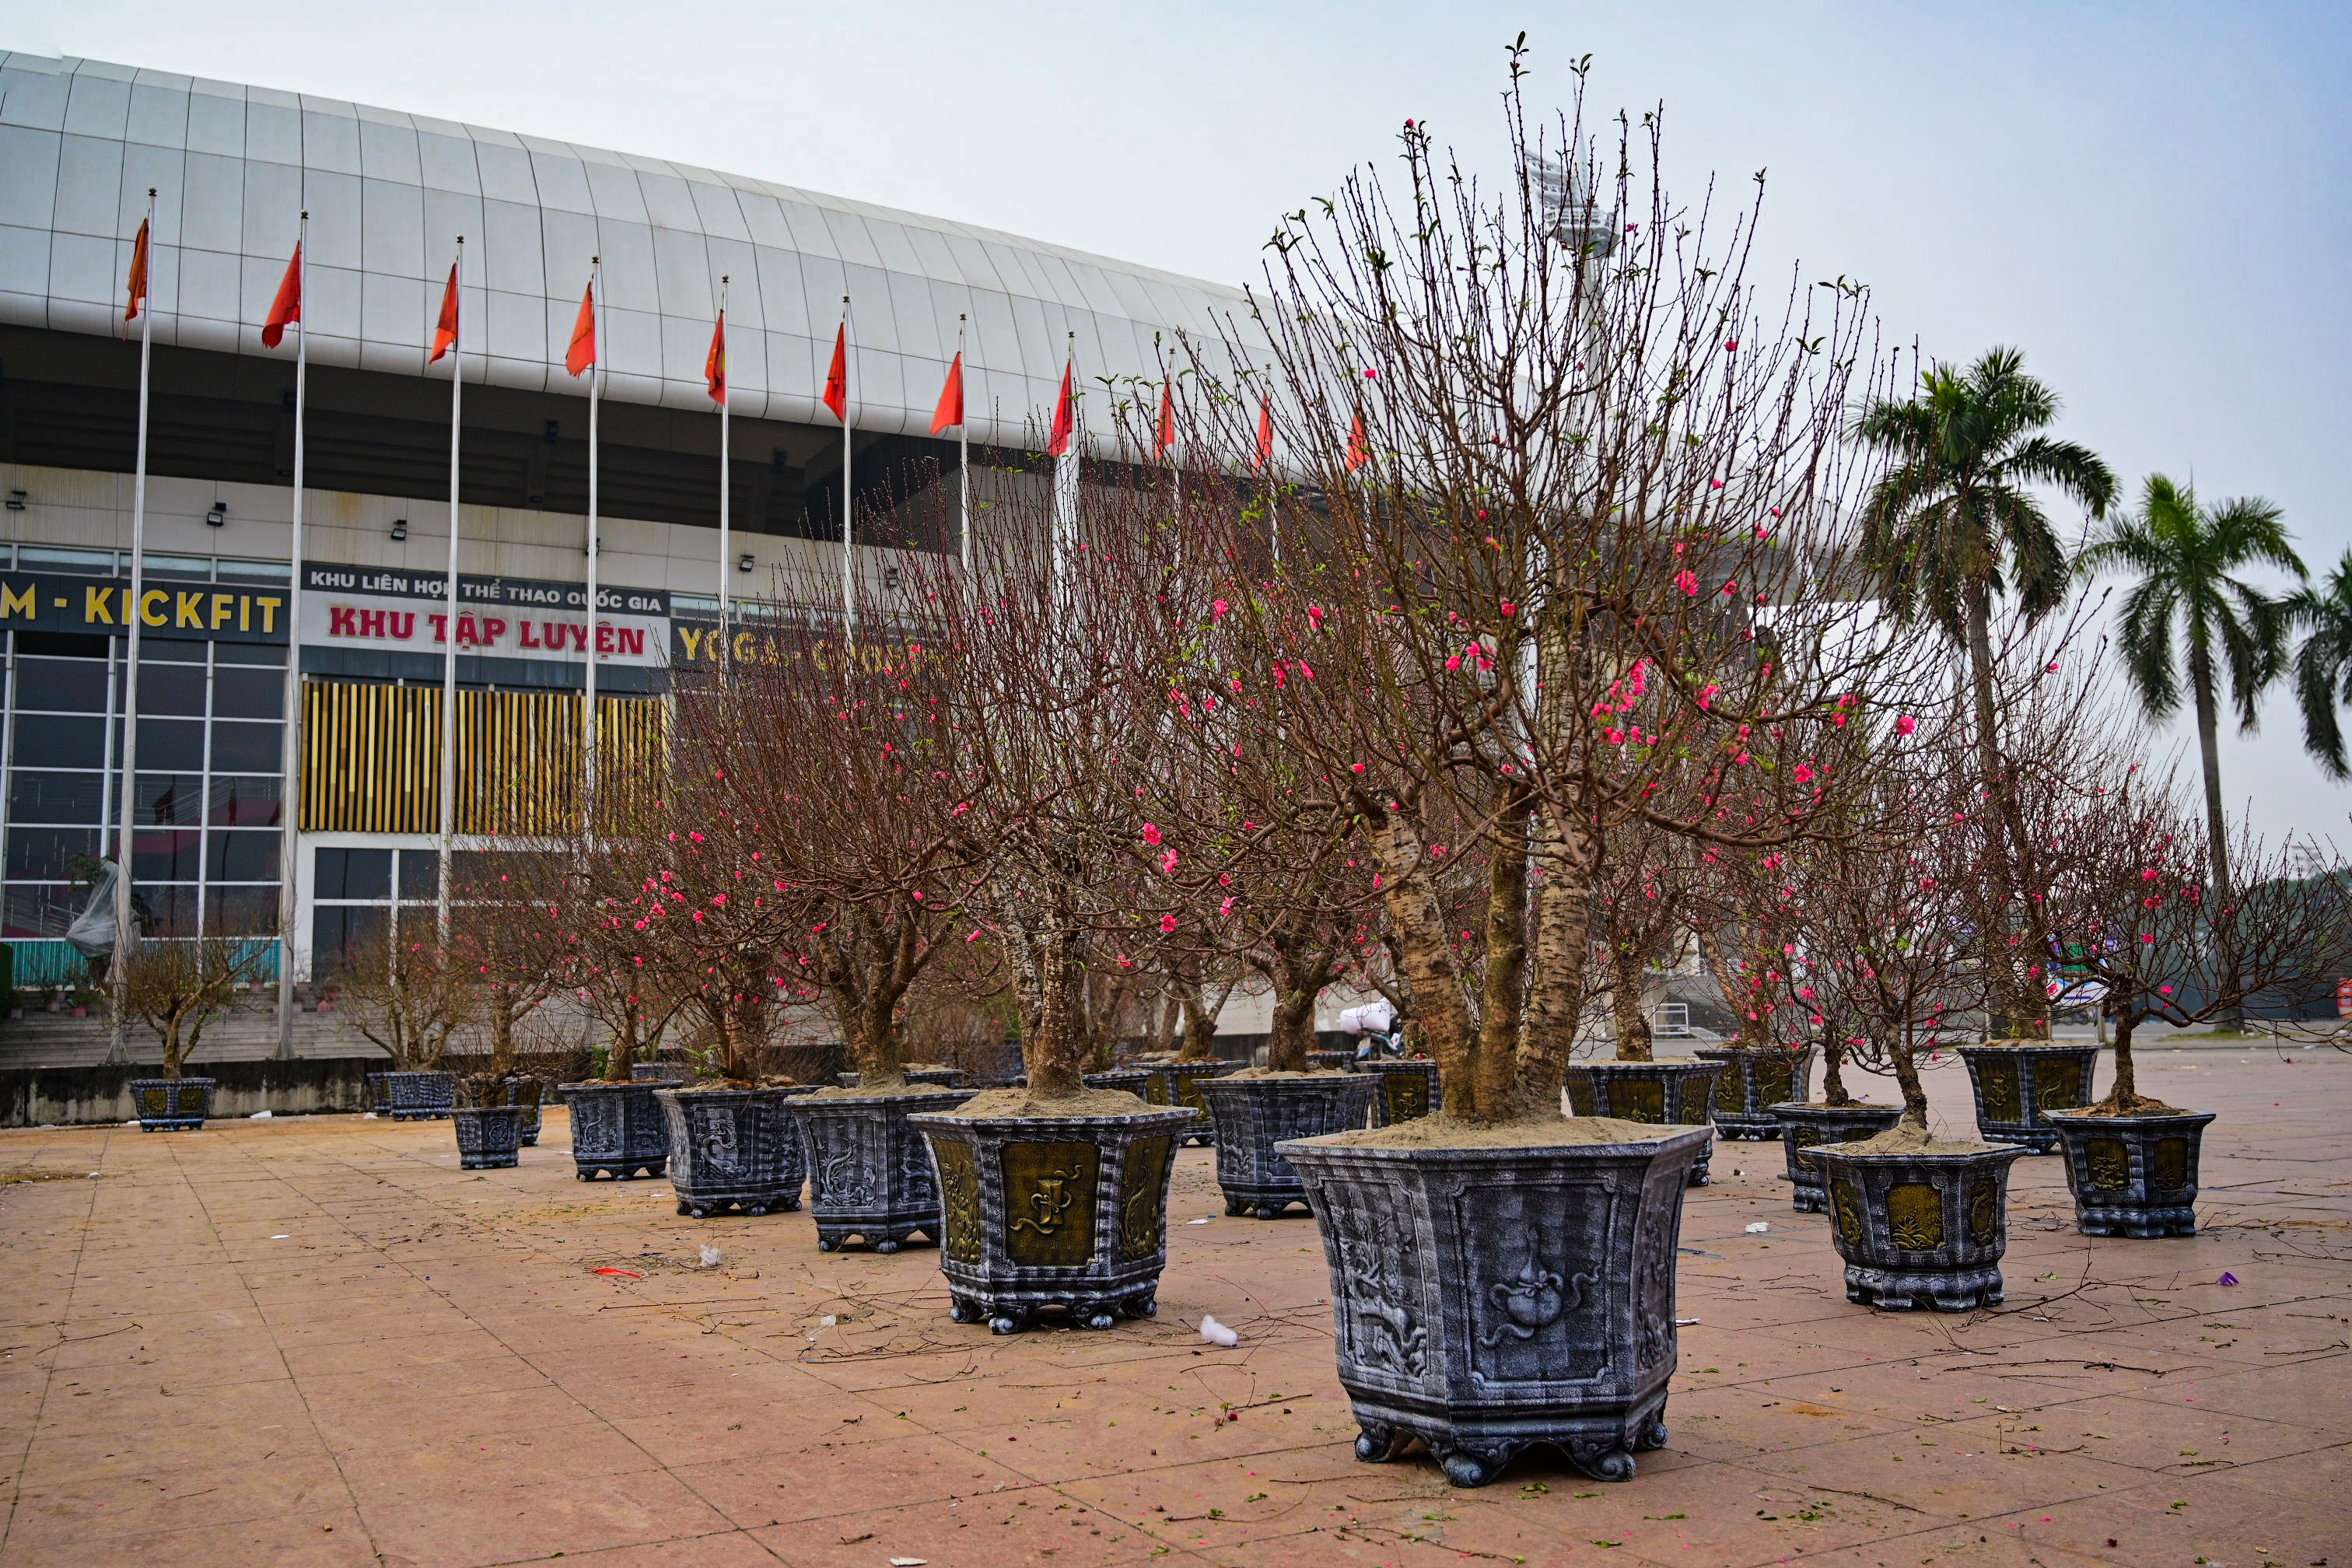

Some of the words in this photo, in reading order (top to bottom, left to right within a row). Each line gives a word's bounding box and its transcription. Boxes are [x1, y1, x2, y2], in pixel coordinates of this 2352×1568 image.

[85, 586, 282, 634] KICKFIT
[311, 571, 355, 588] KHU
[362, 573, 408, 592] LIÊN
[462, 578, 501, 599] THỂ
[507, 586, 561, 604] THAO
[628, 596, 662, 612] GIA
[330, 606, 416, 640] KHU
[428, 610, 508, 651] TẬP
[519, 620, 646, 660] LUYỆN
